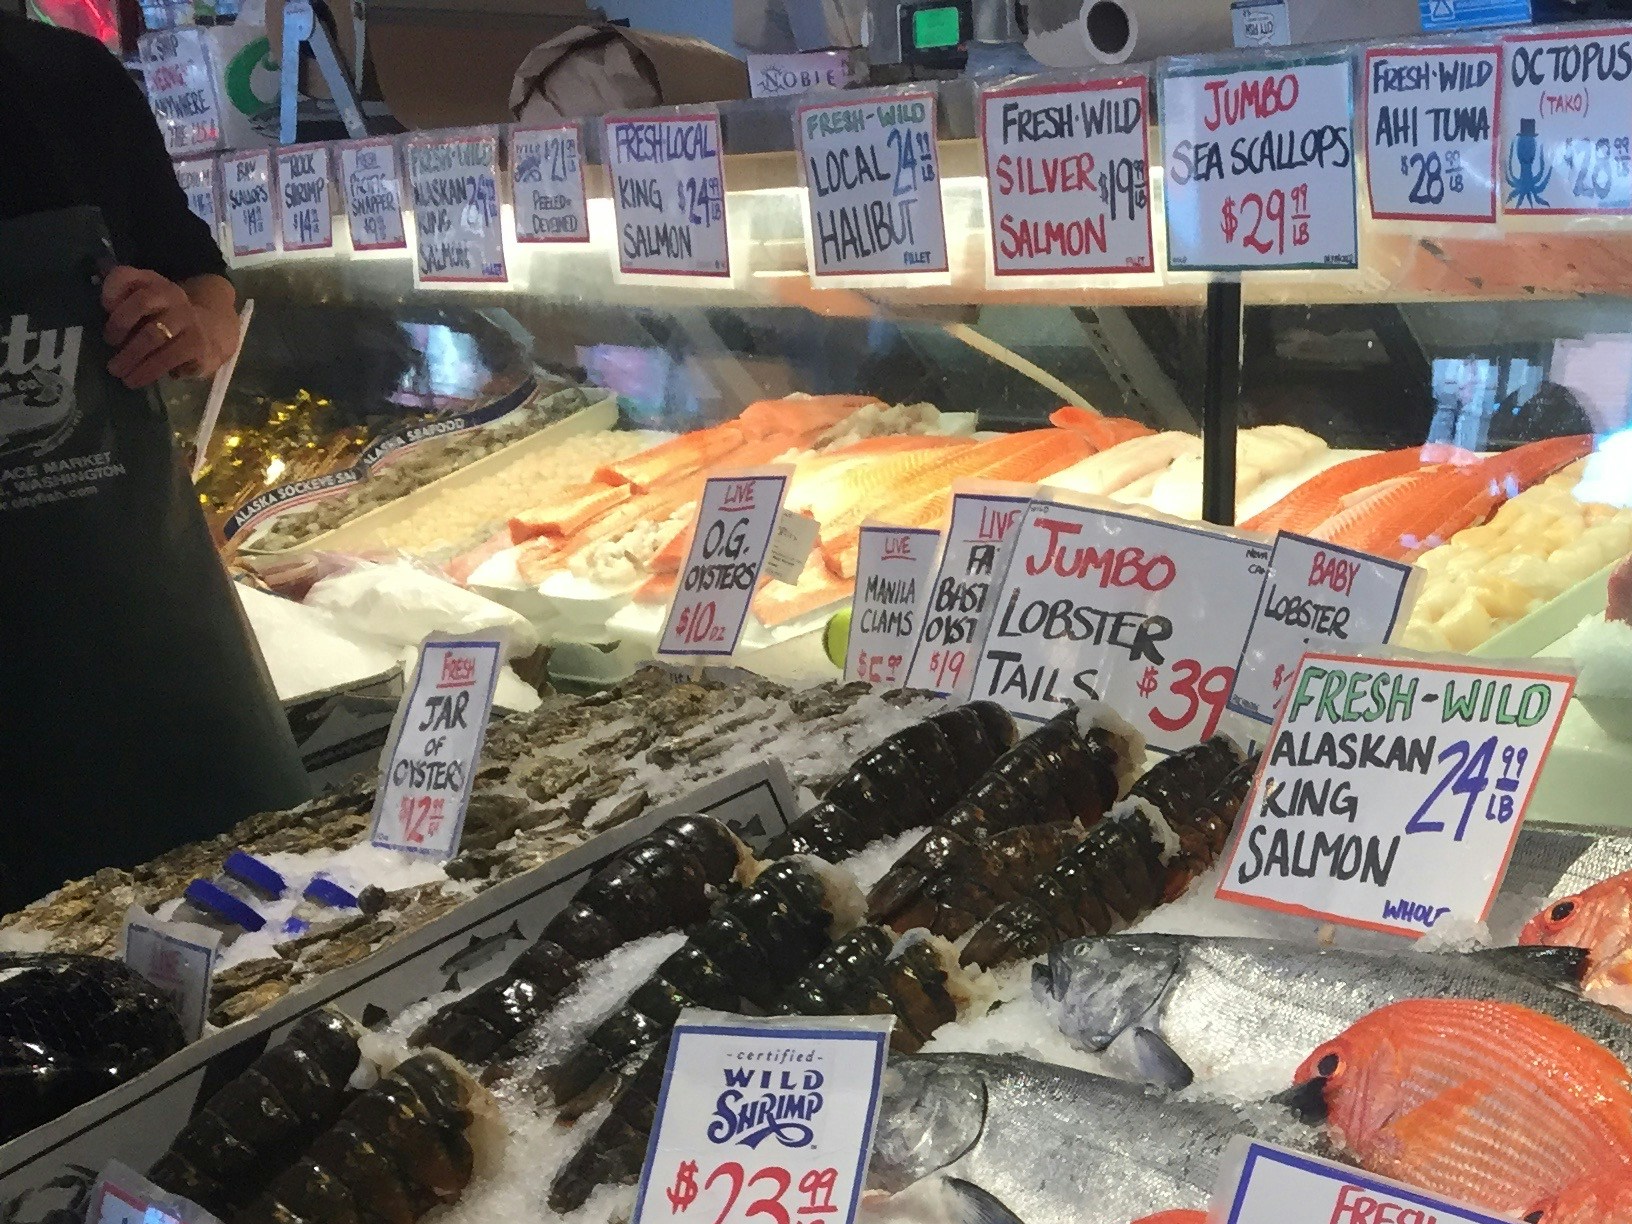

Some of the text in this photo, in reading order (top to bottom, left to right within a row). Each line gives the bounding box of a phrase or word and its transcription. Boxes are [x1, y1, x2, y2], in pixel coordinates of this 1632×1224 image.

[1511, 41, 1632, 88] OCTOPUS
[1203, 73, 1299, 132] JUMBO
[1375, 105, 1490, 148] AHI TUNA
[810, 143, 891, 198] LOCAL
[886, 127, 917, 198] 24
[996, 152, 1098, 196] SILVER
[1169, 125, 1350, 186] SEA SCALLOPS
[1400, 150, 1445, 205] $28
[618, 175, 664, 214] KING
[677, 177, 711, 228] $24
[1098, 157, 1136, 221] $19
[623, 222, 692, 260] SALMON
[816, 198, 918, 265] HALIBUT
[1000, 213, 1107, 260] SALMON
[1220, 183, 1310, 256] $29 99 LB
[405, 417, 466, 442] SEAFOOD
[13, 463, 127, 493] WASHINGTON
[43, 450, 111, 474] MARKET
[234, 474, 335, 527] ALASKA SOCKEYE
[724, 480, 756, 505] LIVE
[702, 517, 750, 560] O.G.
[884, 535, 912, 554] LIVE
[1025, 517, 1177, 592] JUMBO
[684, 562, 757, 593] OYSTERS
[864, 574, 917, 605] MANILA
[1307, 550, 1362, 597] BABY
[676, 600, 718, 645] $10
[860, 609, 914, 637] CLAMS
[997, 586, 1174, 666] LOBSTER
[1263, 583, 1351, 640] LOBSTER
[441, 651, 477, 682] FRESH
[929, 650, 966, 690] $19
[986, 649, 1100, 708] TAILS
[418, 690, 470, 733] JAR
[1136, 658, 1238, 743] $39
[424, 735, 447, 757] OF
[1270, 730, 1438, 775] ALASKAN
[393, 758, 466, 792] OYSTERS
[1404, 735, 1529, 843] 24 99 LB
[1258, 776, 1359, 823] KING
[1237, 823, 1401, 888] SALMON
[723, 1065, 825, 1091] WILD
[706, 1088, 825, 1150] SHRIMP
[797, 1167, 839, 1208] 99
